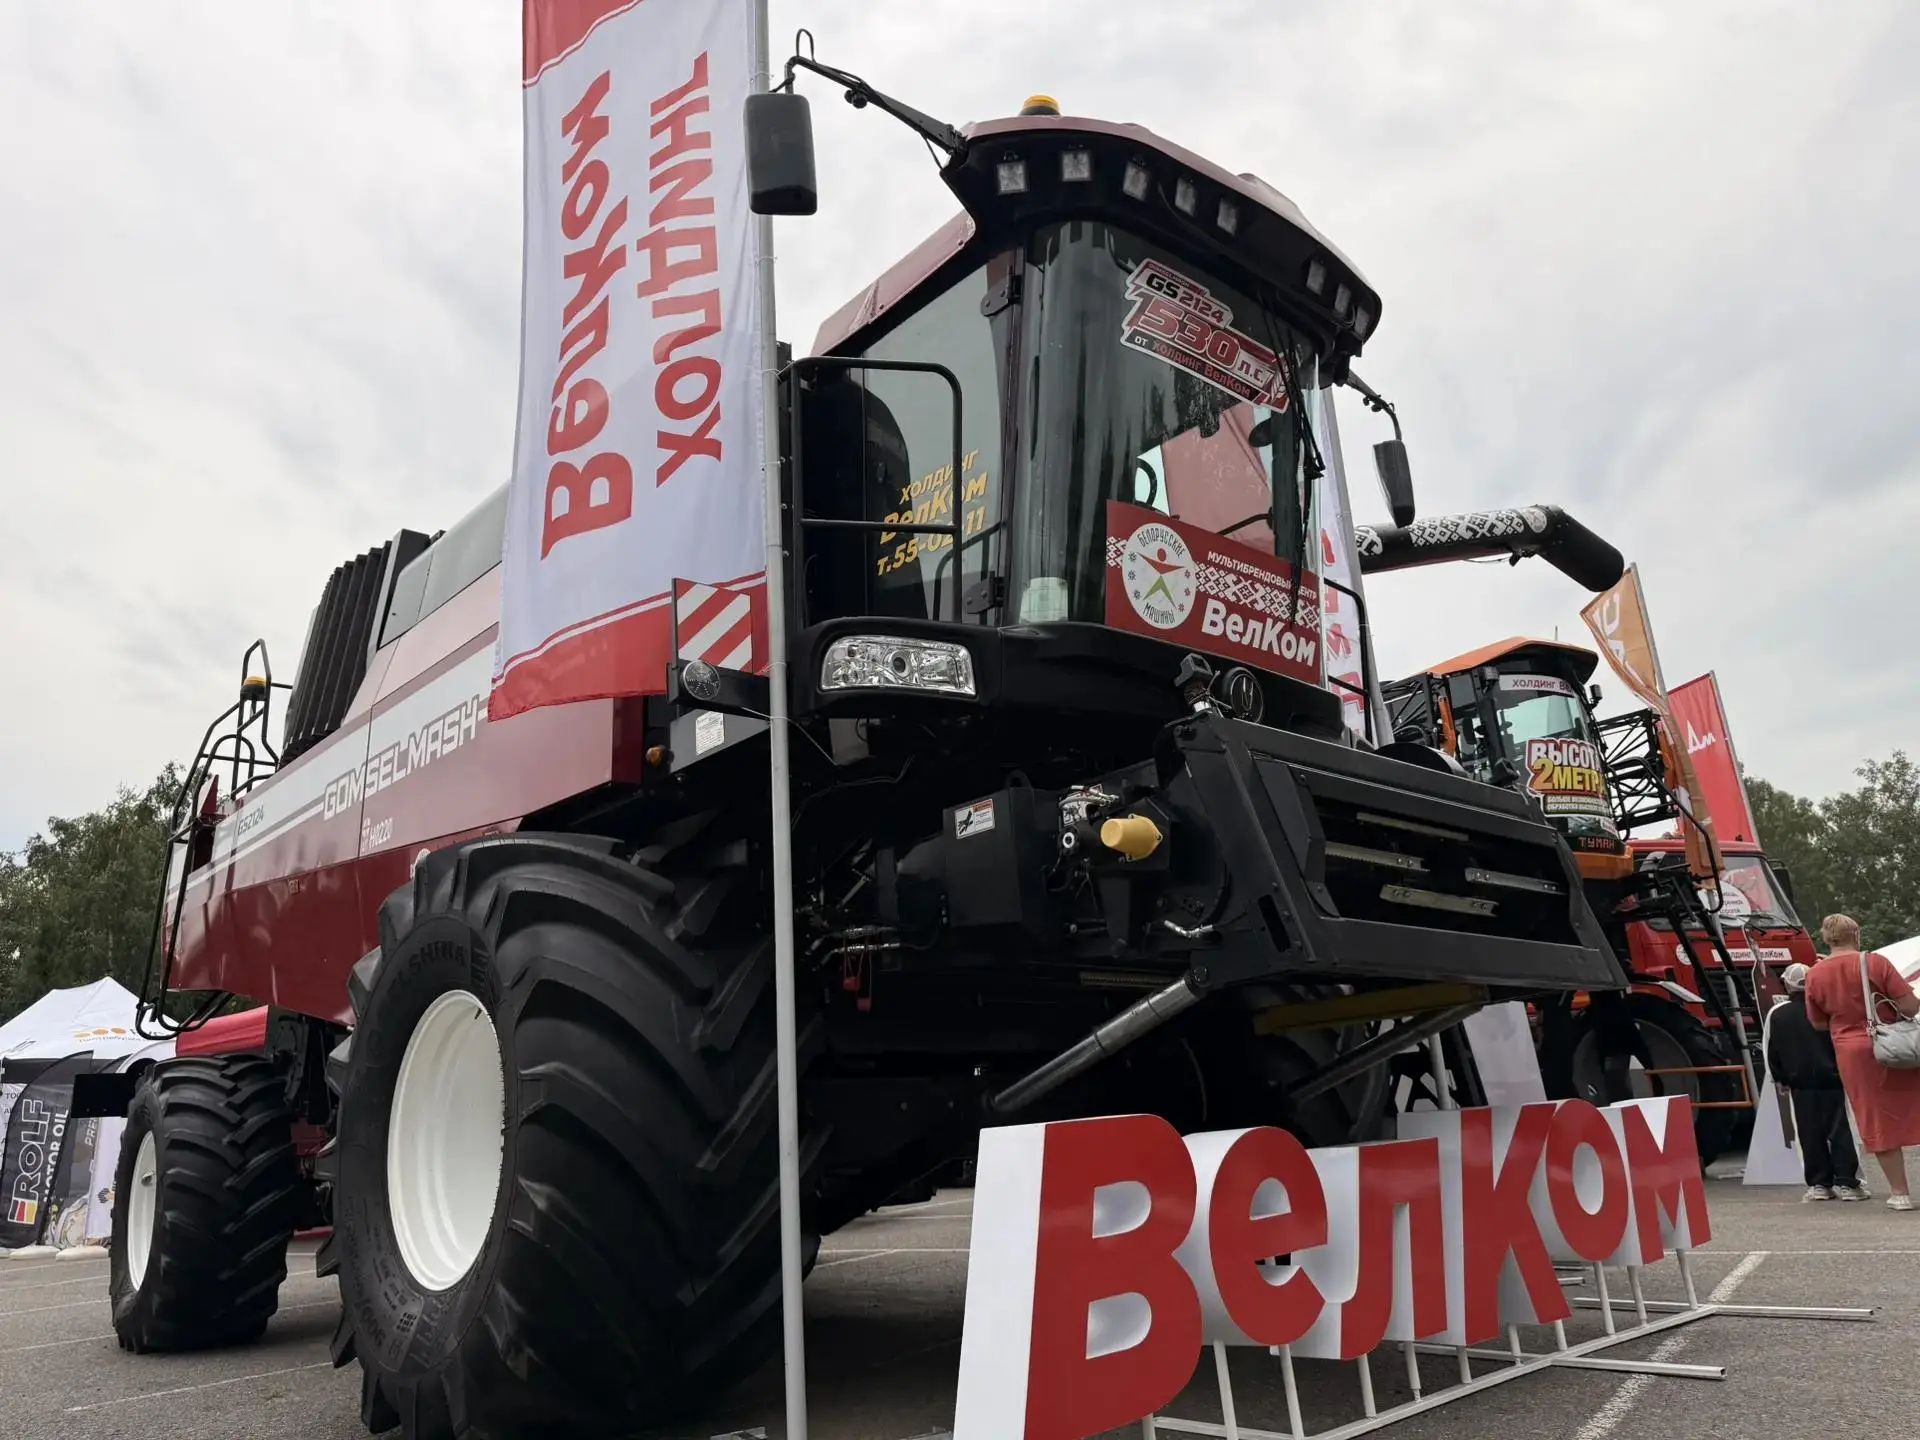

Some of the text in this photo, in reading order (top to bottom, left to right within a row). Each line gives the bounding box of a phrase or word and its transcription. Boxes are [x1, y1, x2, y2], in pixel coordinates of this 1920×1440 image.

[1143, 602, 1175, 625] МАШИНЫ
[1201, 598, 1316, 667] ВелКом
[324, 694, 480, 822] GOMSELMASH
[12, 1099, 51, 1201] ROLF
[53, 1109, 69, 1137] OIL
[1022, 1094, 1712, 1440] ВелКом
